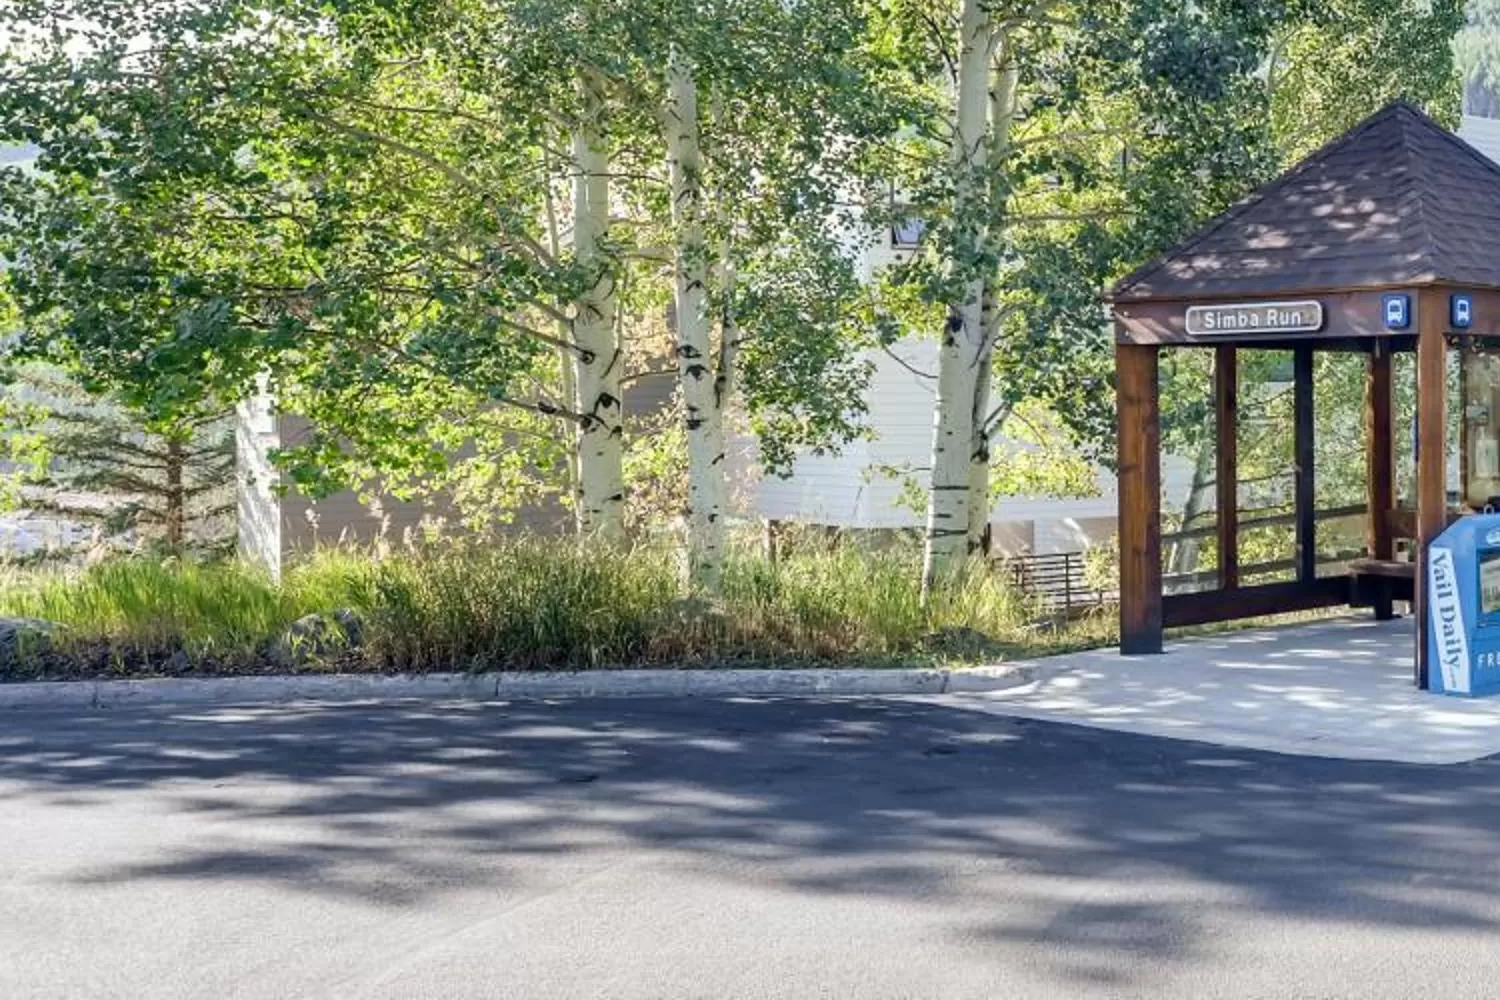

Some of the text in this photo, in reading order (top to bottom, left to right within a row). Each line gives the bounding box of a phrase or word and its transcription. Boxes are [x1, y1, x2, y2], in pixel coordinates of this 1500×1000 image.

[1204, 308, 1301, 329] Simba Run
[1432, 551, 1453, 599] Vail
[1440, 605, 1462, 668] Daily
